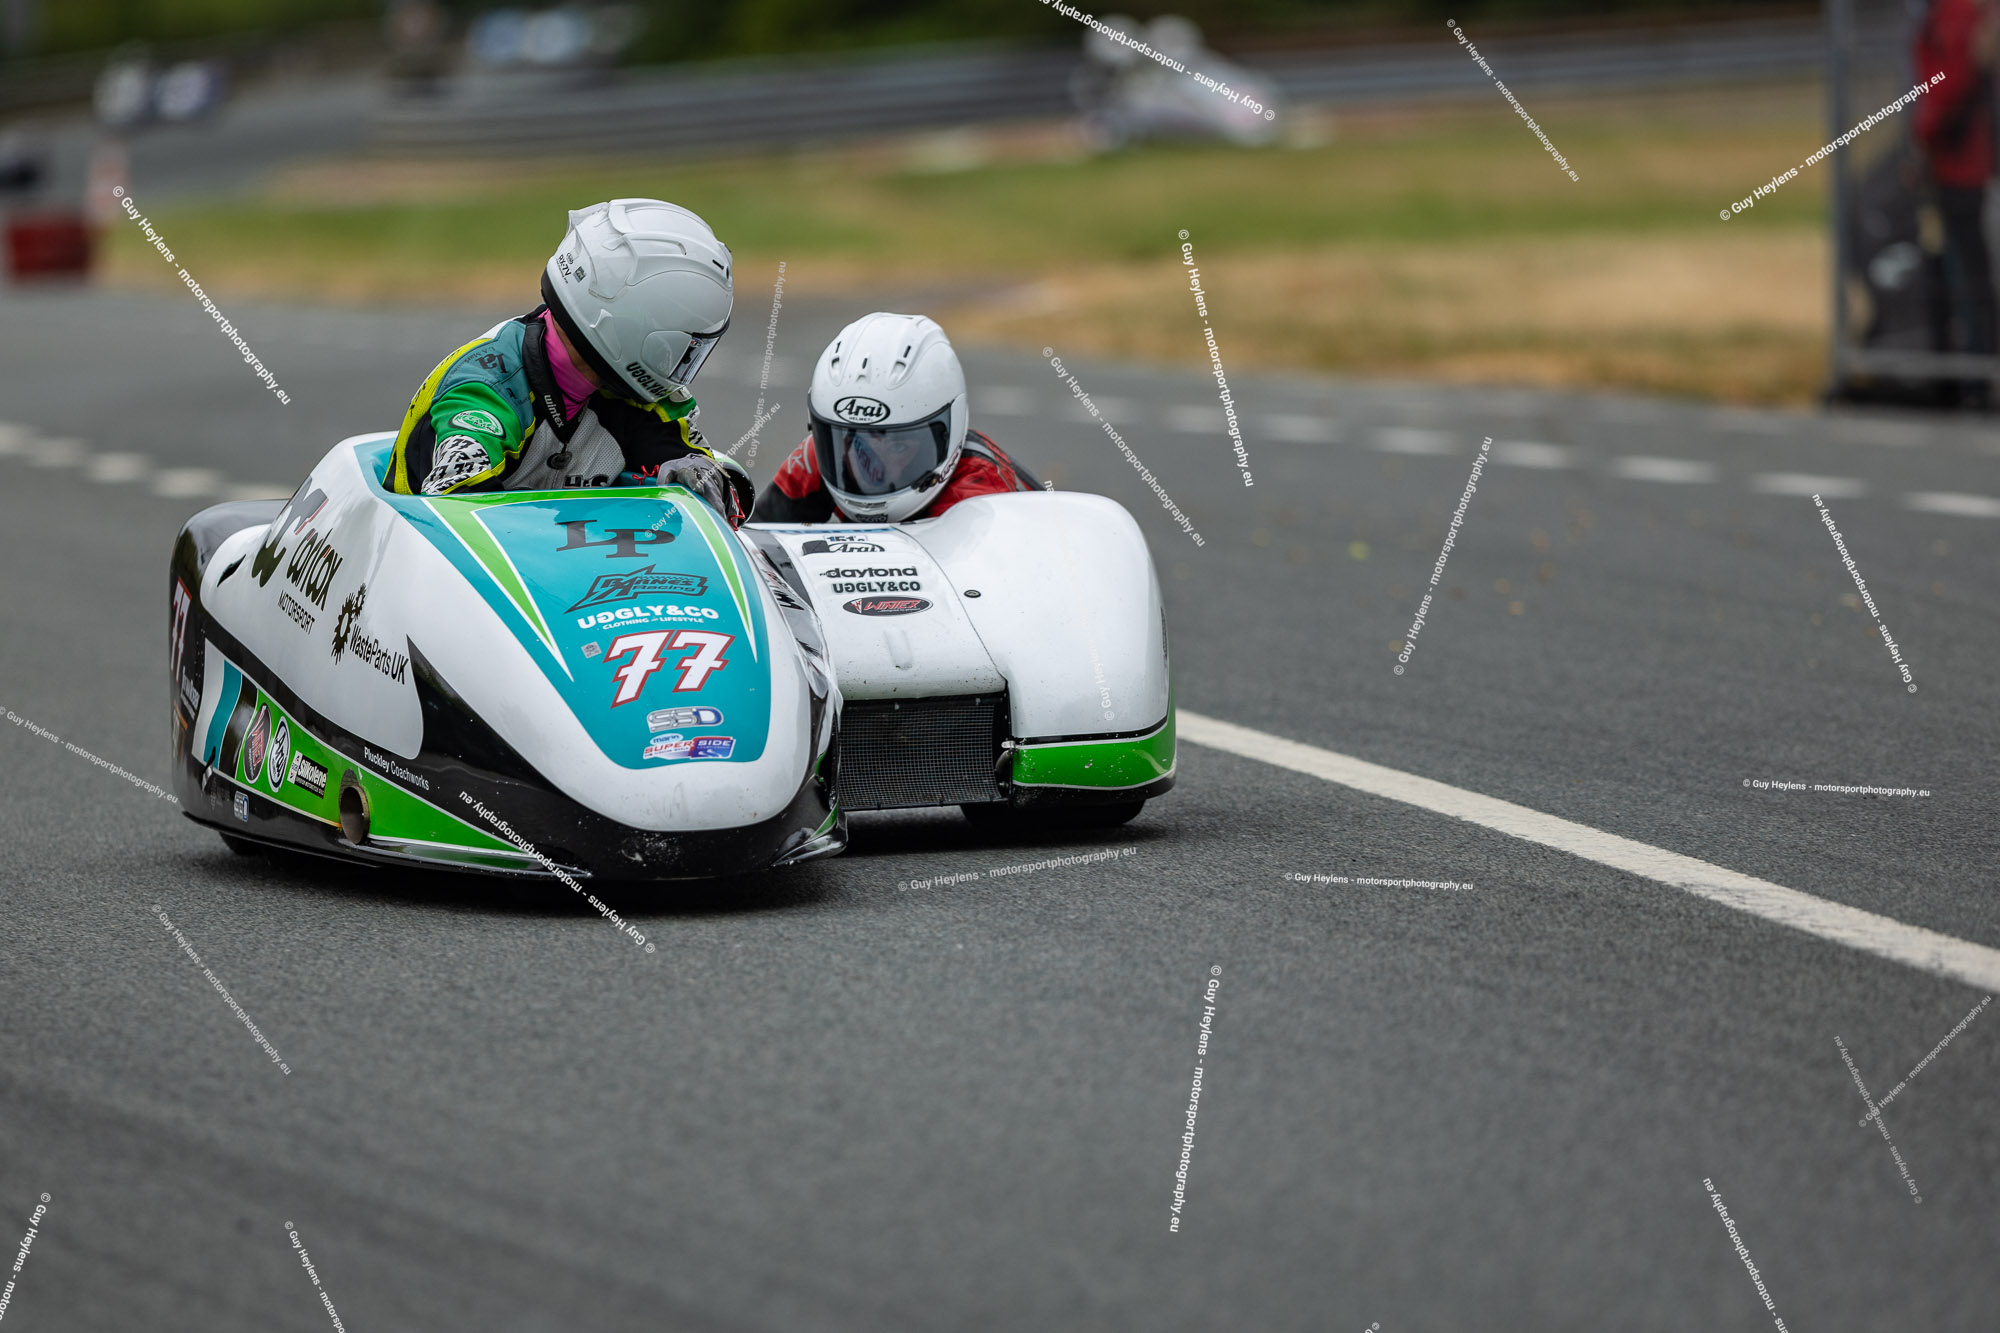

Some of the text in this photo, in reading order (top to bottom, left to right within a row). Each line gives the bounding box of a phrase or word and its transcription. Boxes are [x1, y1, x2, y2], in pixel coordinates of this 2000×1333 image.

[837, 399, 884, 417] Arai
[278, 590, 315, 635] MOTORSPORT
[602, 617, 650, 630] CLOTHING
[391, 653, 409, 685] UK
[602, 629, 737, 709] 77
[364, 746, 430, 791] Pluckley Coachworks
